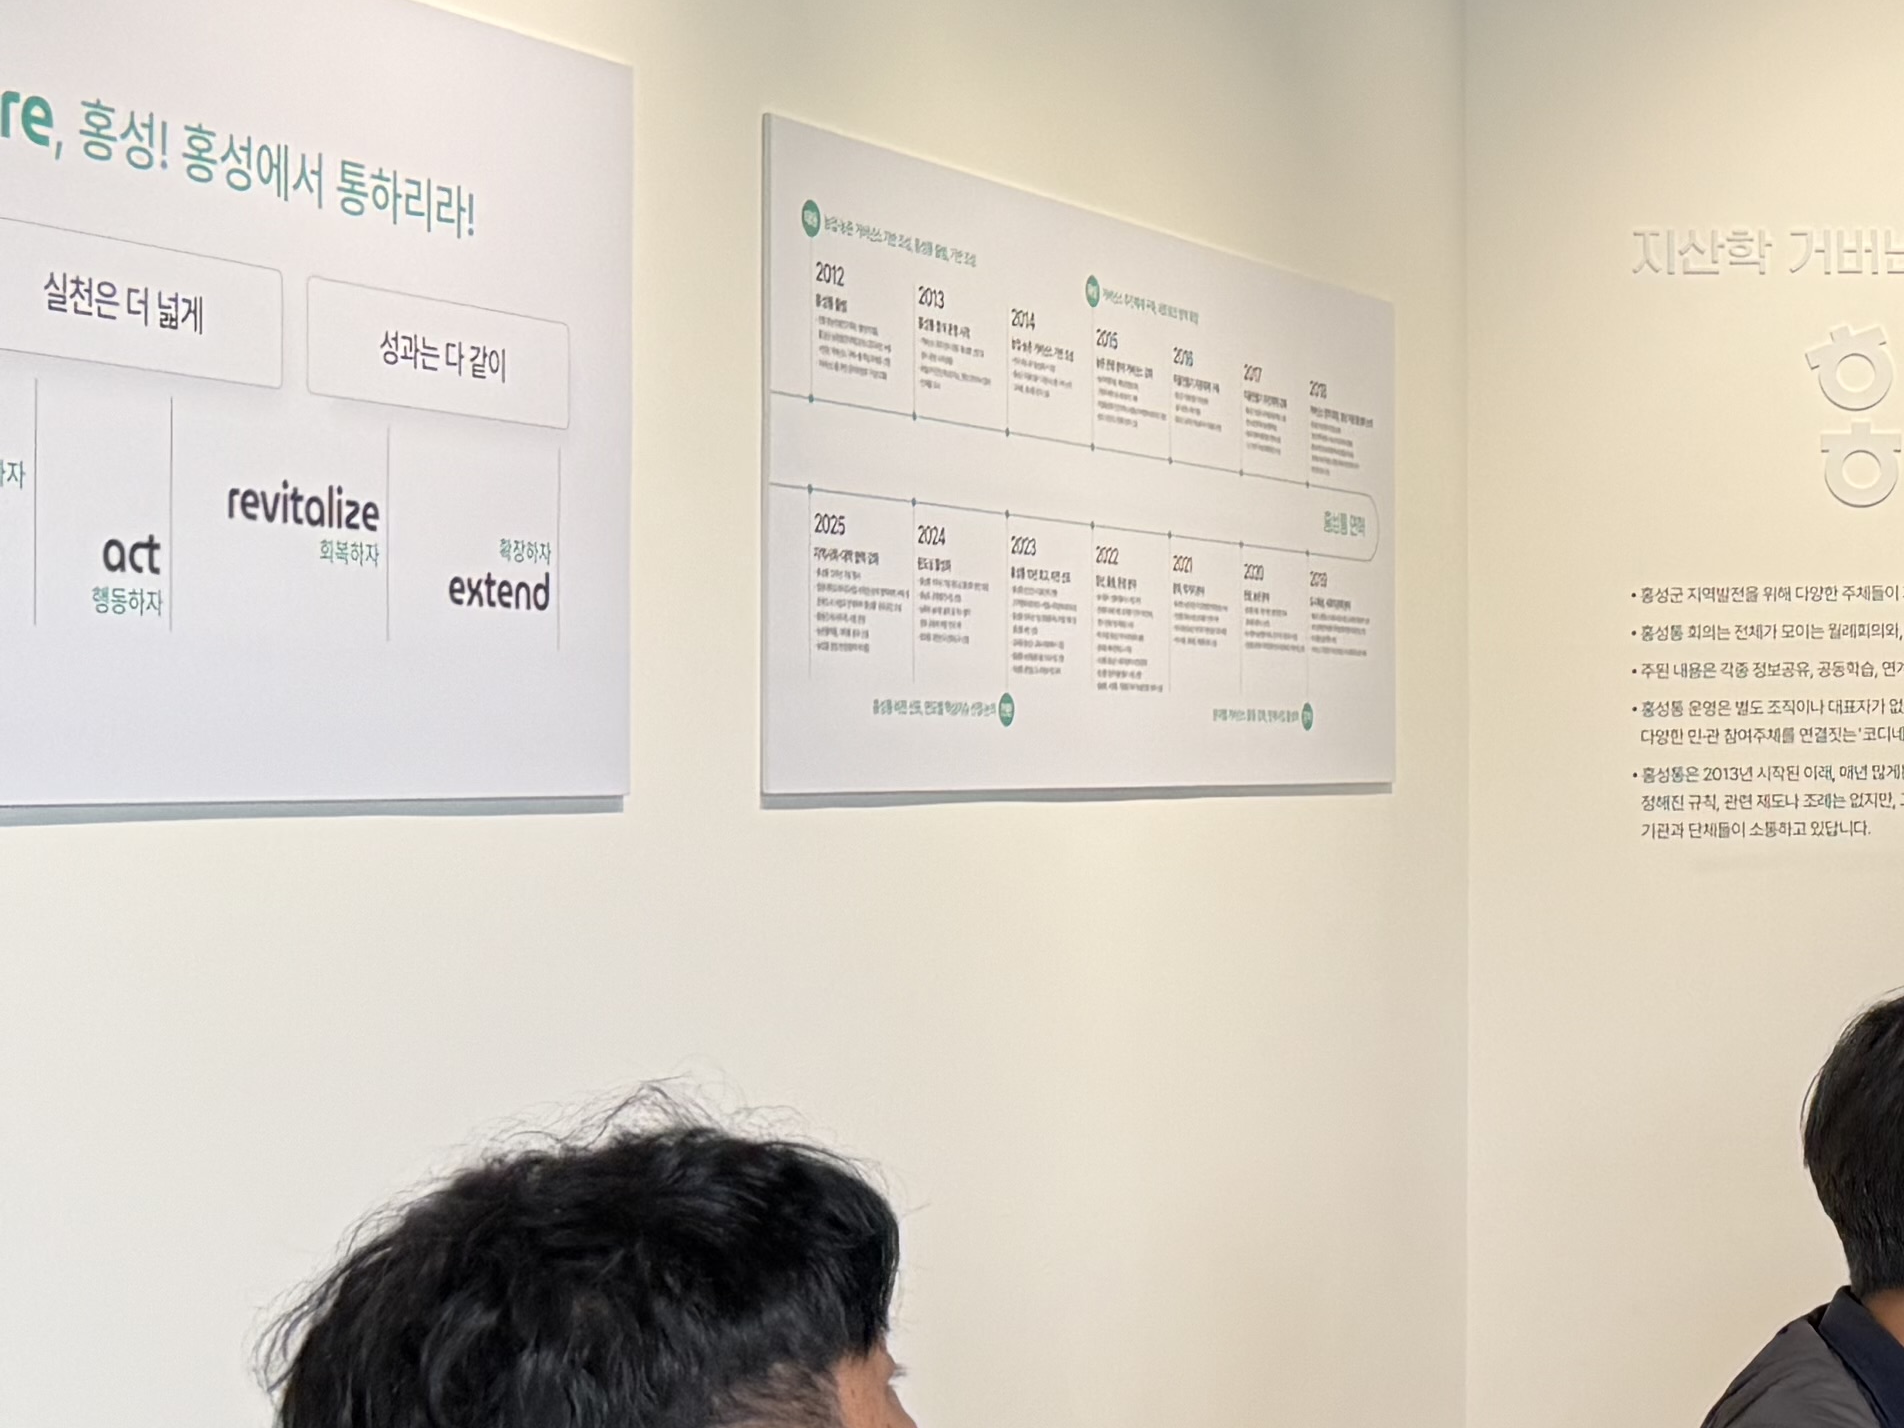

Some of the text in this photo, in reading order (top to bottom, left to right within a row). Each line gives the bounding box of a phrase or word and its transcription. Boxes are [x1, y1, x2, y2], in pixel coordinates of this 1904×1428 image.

[79, 98, 477, 240] 홍성! 홍성에서 통하리라!
[1632, 226, 1772, 277] 지산학
[816, 262, 845, 286] 2012
[44, 272, 203, 335] 실천은 더 넓게
[919, 286, 945, 309] 2013
[1012, 309, 1036, 330] 2014
[380, 326, 507, 385] 성과는 다 같이
[227, 478, 380, 534] revitalize
[814, 513, 846, 535] 2025
[918, 525, 946, 546] 2024
[102, 534, 161, 575] act
[319, 538, 380, 569] 회복하자
[92, 586, 163, 618] 행동하자
[449, 570, 551, 614] extend
[1641, 586, 1683, 603] 홍성군
[1764, 586, 1791, 602] 위해
[1796, 585, 1838, 602] 다양한
[1842, 585, 1898, 601] 주체들이
[1641, 624, 1683, 642] 홍성통
[1687, 624, 1731, 641] 회의는
[1735, 624, 1777, 641] 전체가
[1781, 623, 1824, 641] 모이는
[1641, 662, 1669, 679] 주된
[1674, 662, 1716, 679] 내용은
[1721, 661, 1748, 678] 각종
[1753, 661, 1813, 678] 정보공유,
[1642, 699, 1683, 717] 홍성통
[1689, 699, 1731, 717] 운영은
[1735, 699, 1764, 716] 별도
[1767, 698, 1824, 716] 조직이나
[1828, 698, 1885, 715] 대표자가
[1641, 728, 1683, 745] 다양한
[1642, 766, 1699, 784] 홍성통은
[1703, 766, 1752, 783] 2013년
[1757, 765, 1800, 782] 시작된
[1840, 764, 1867, 782] 매년
[1641, 794, 1684, 811] 정해진
[1688, 793, 1720, 811] 규칙,
[1724, 793, 1752, 810] 관련
[1757, 792, 1798, 810] 제도나
[1641, 820, 1871, 840] 기관과 단체들이 소통하고 있답니다.
